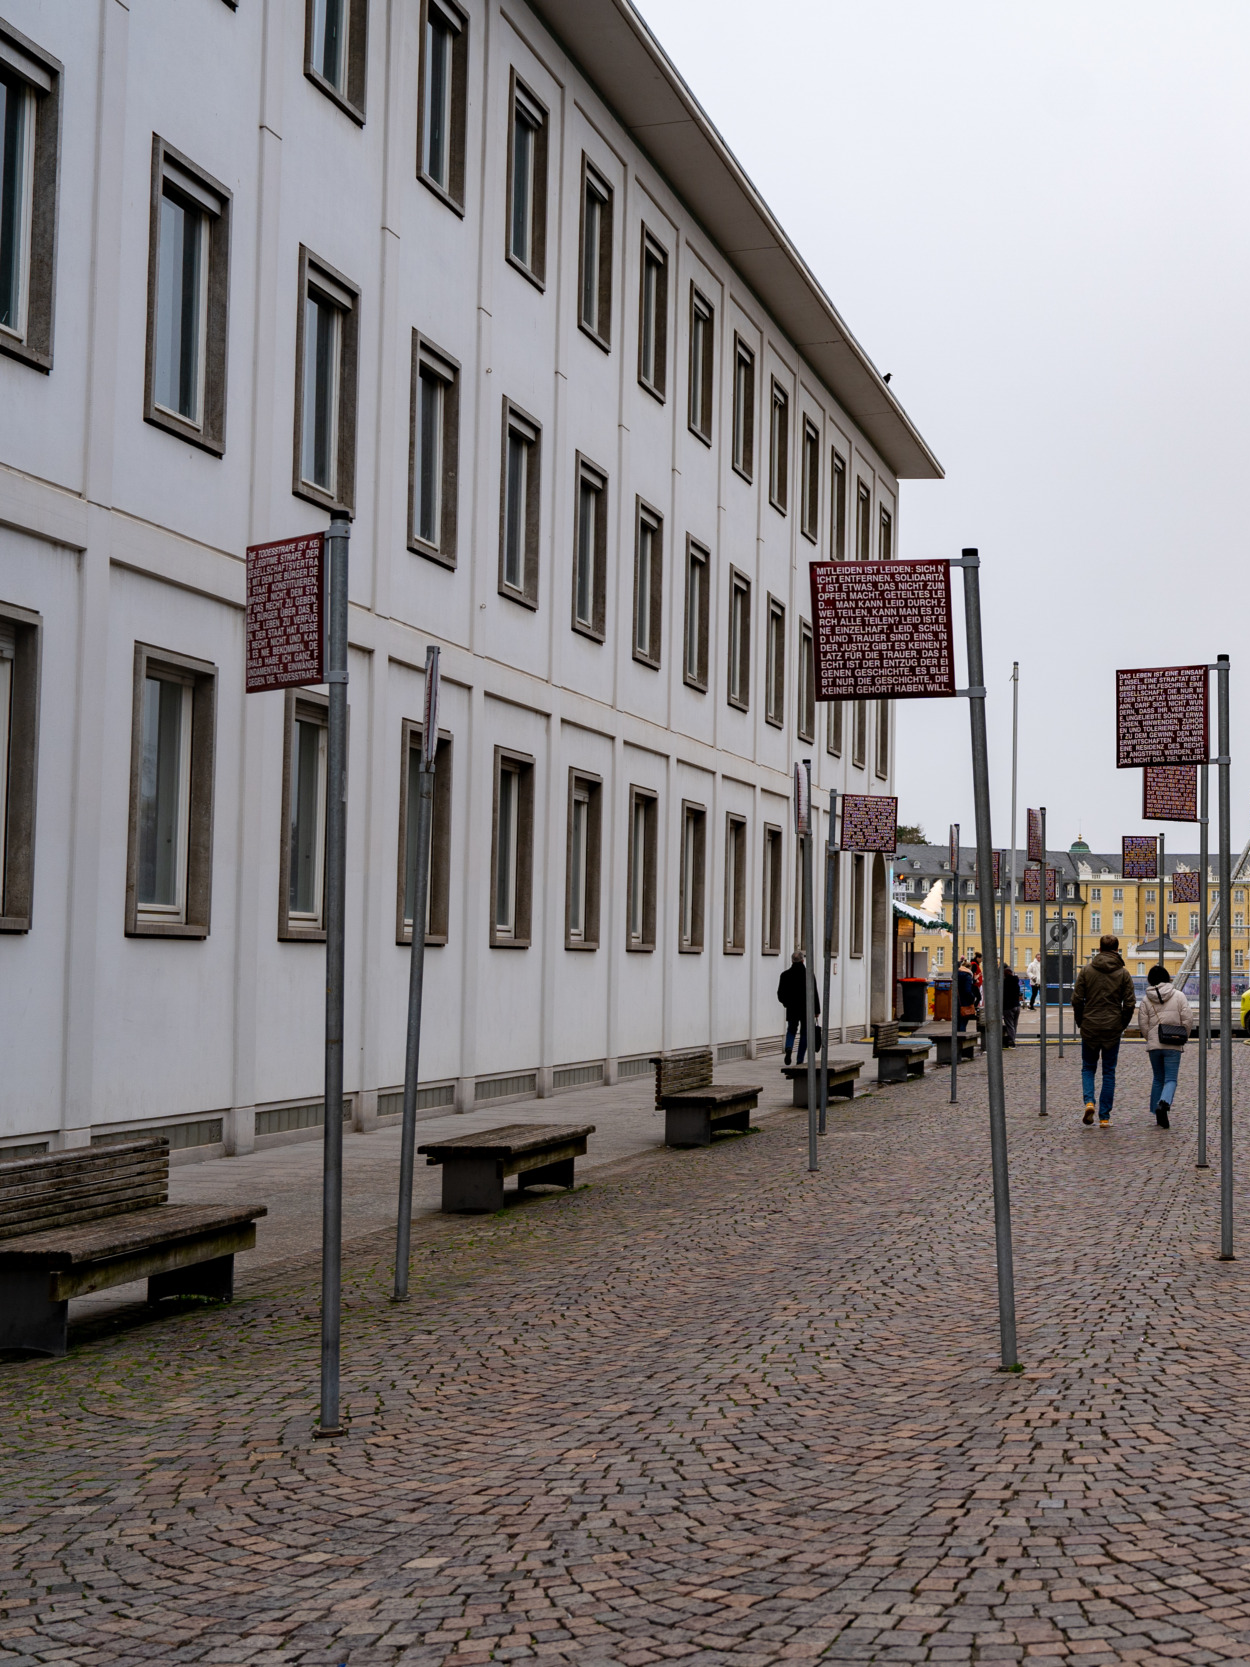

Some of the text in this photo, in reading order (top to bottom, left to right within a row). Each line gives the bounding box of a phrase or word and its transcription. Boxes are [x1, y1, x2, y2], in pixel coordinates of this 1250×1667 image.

[895, 572, 944, 580] SOLIDARITÄ
[874, 676, 931, 684] GESCHICHTE,
[856, 684, 891, 692] GEHÖRT
